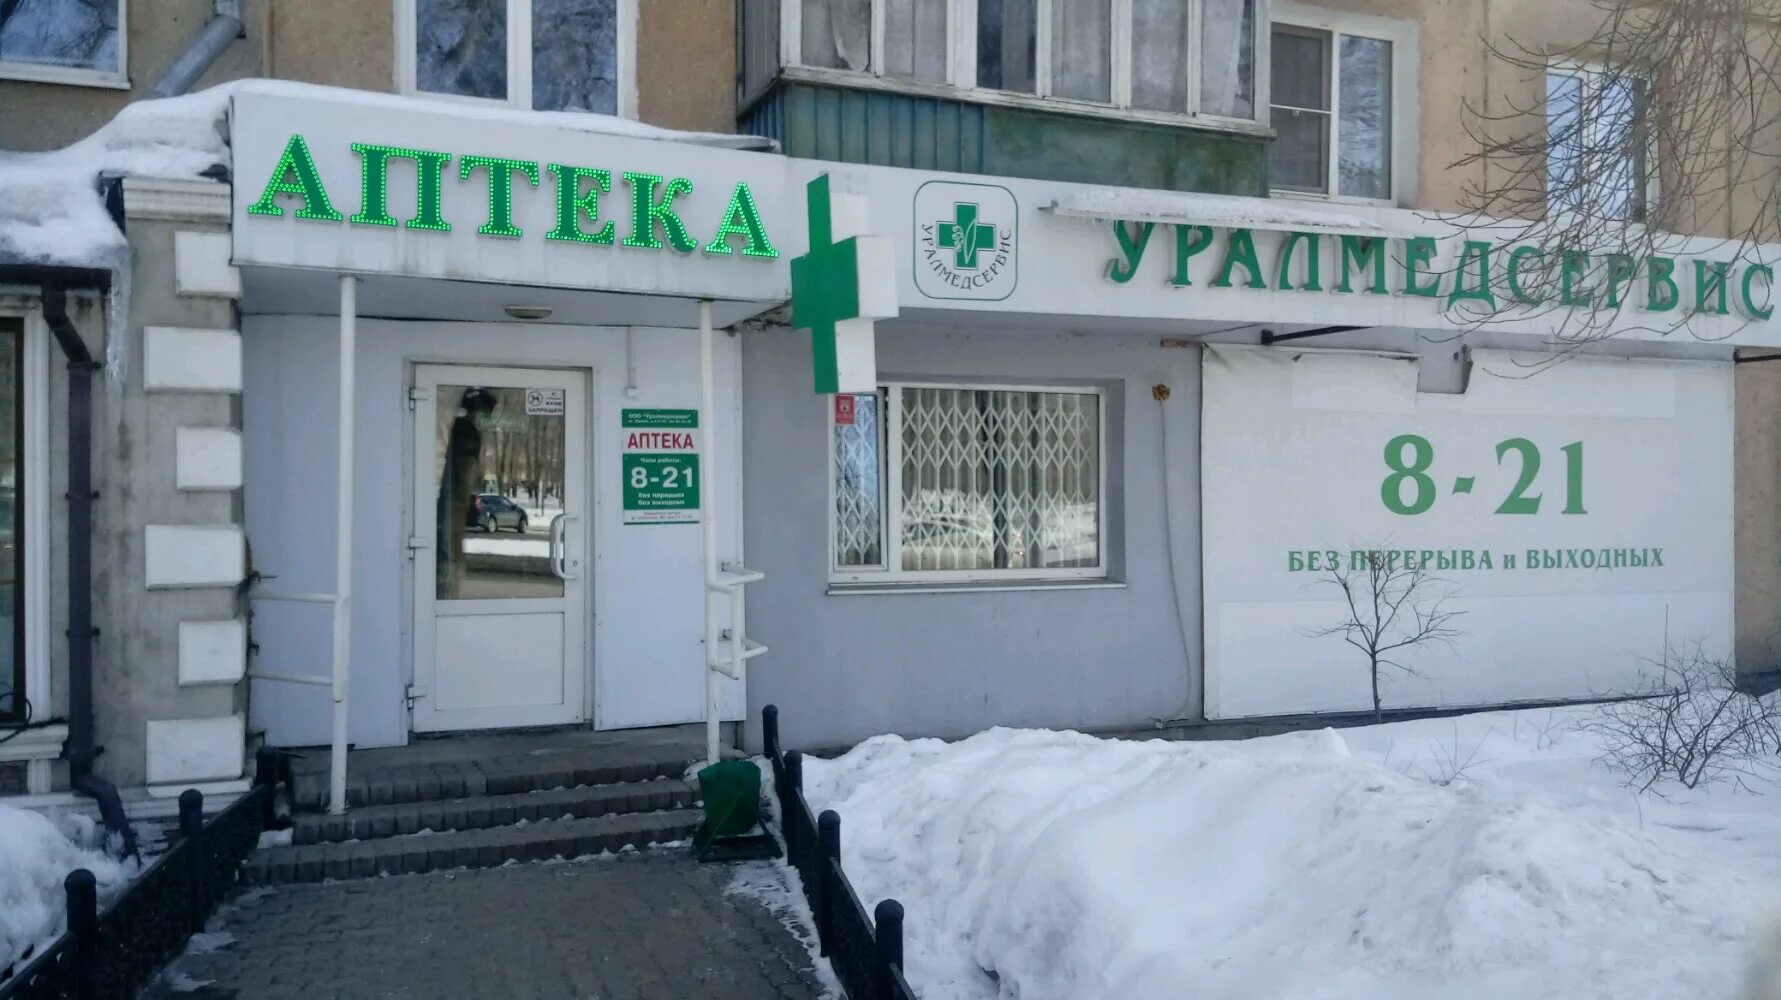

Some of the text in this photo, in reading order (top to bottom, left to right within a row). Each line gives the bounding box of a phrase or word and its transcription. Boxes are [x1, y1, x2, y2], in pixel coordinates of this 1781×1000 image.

[247, 133, 780, 260] АПТЕКА
[921, 224, 1012, 290] УРАЛМЕДСЕРВИС
[1104, 219, 1775, 322] УРАЛМЕДСЕРВИС
[628, 433, 694, 449] АПТЕКА
[630, 466, 694, 489] 8-21
[1288, 550, 1341, 572] БЕЗ
[1526, 548, 1664, 572] ВЫХОДНЫХ
